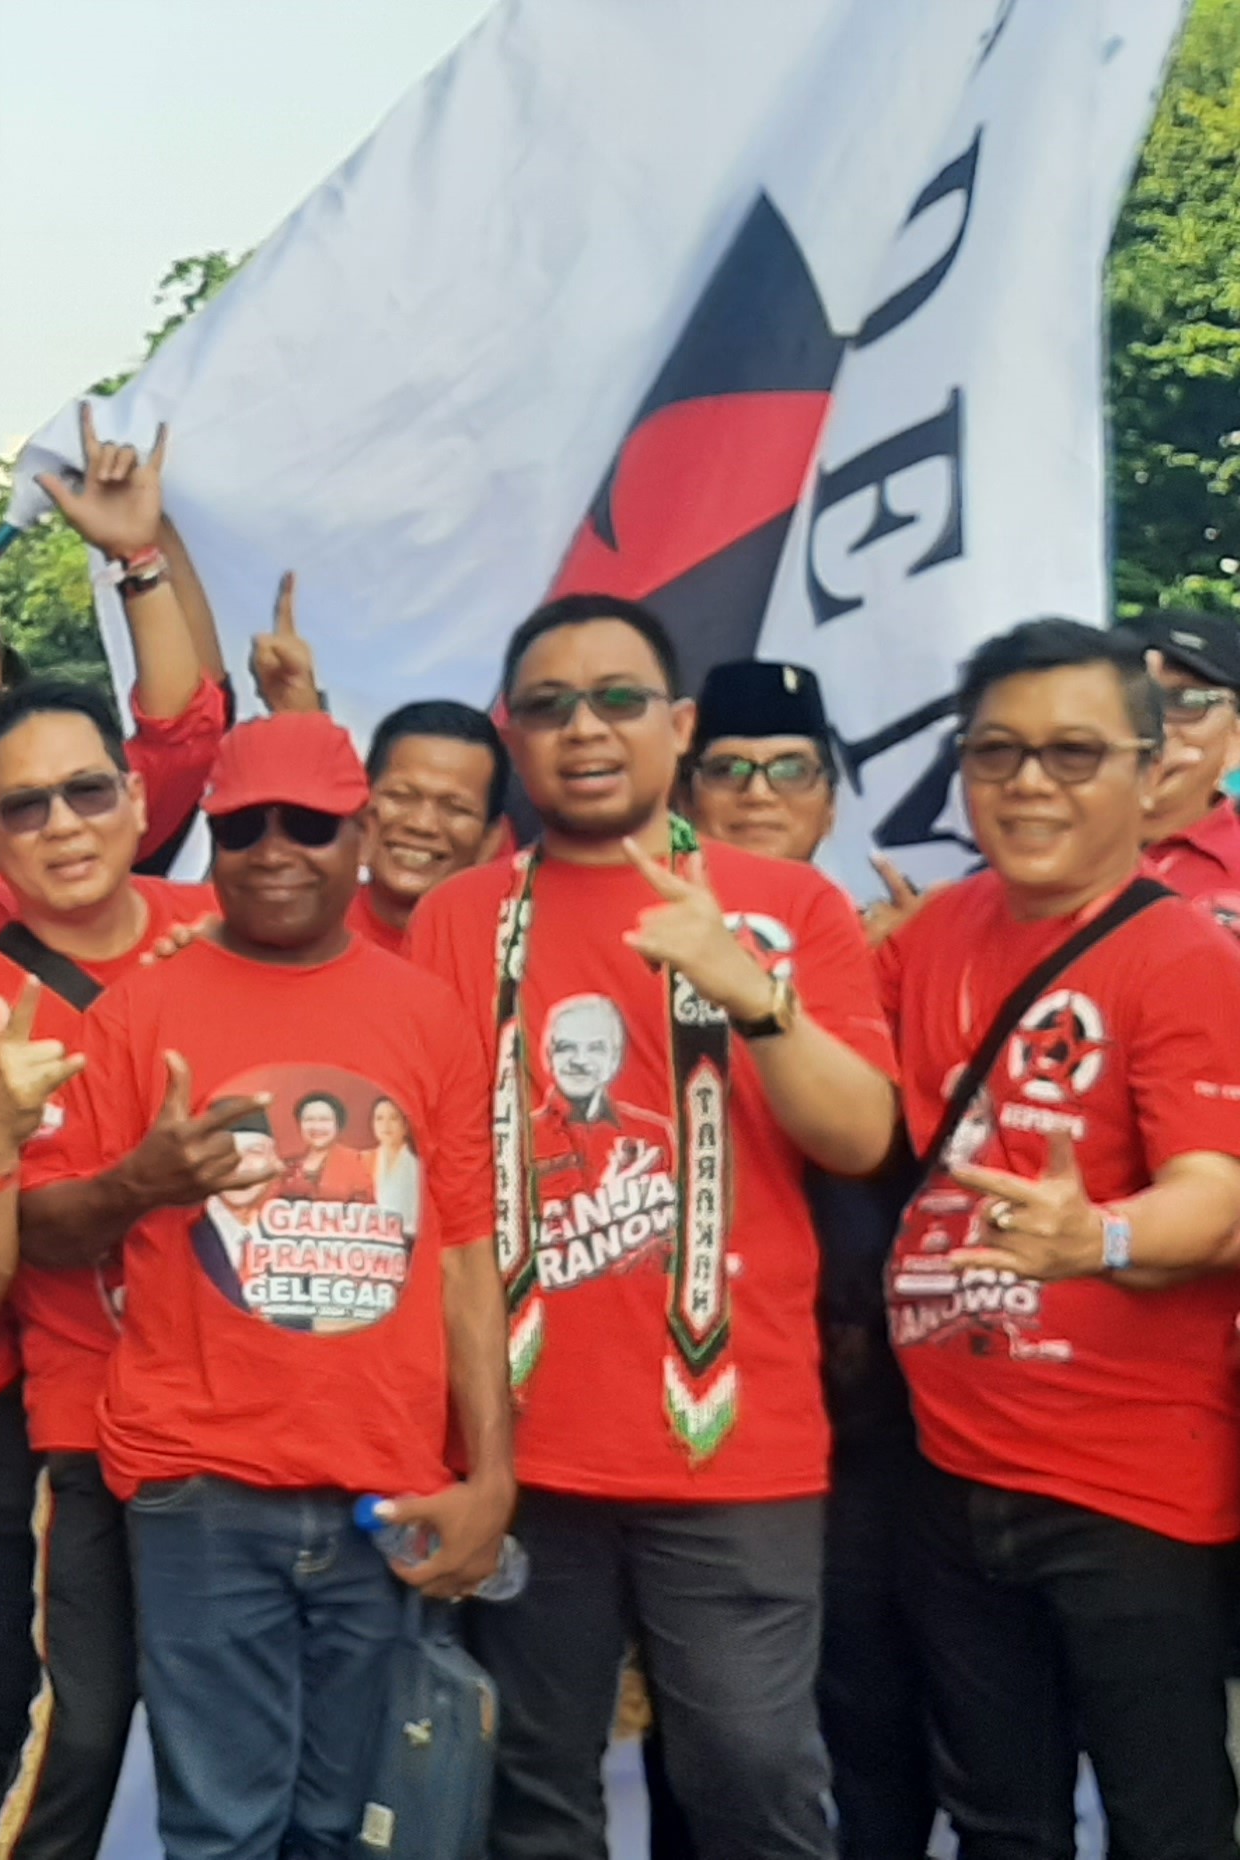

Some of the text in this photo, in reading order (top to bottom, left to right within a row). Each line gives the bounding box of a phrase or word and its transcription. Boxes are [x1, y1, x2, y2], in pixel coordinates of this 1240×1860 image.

[260, 1197, 405, 1246] GANJAR
[250, 1238, 408, 1285] PRANOWO
[242, 1277, 398, 1314] GELEGAR
